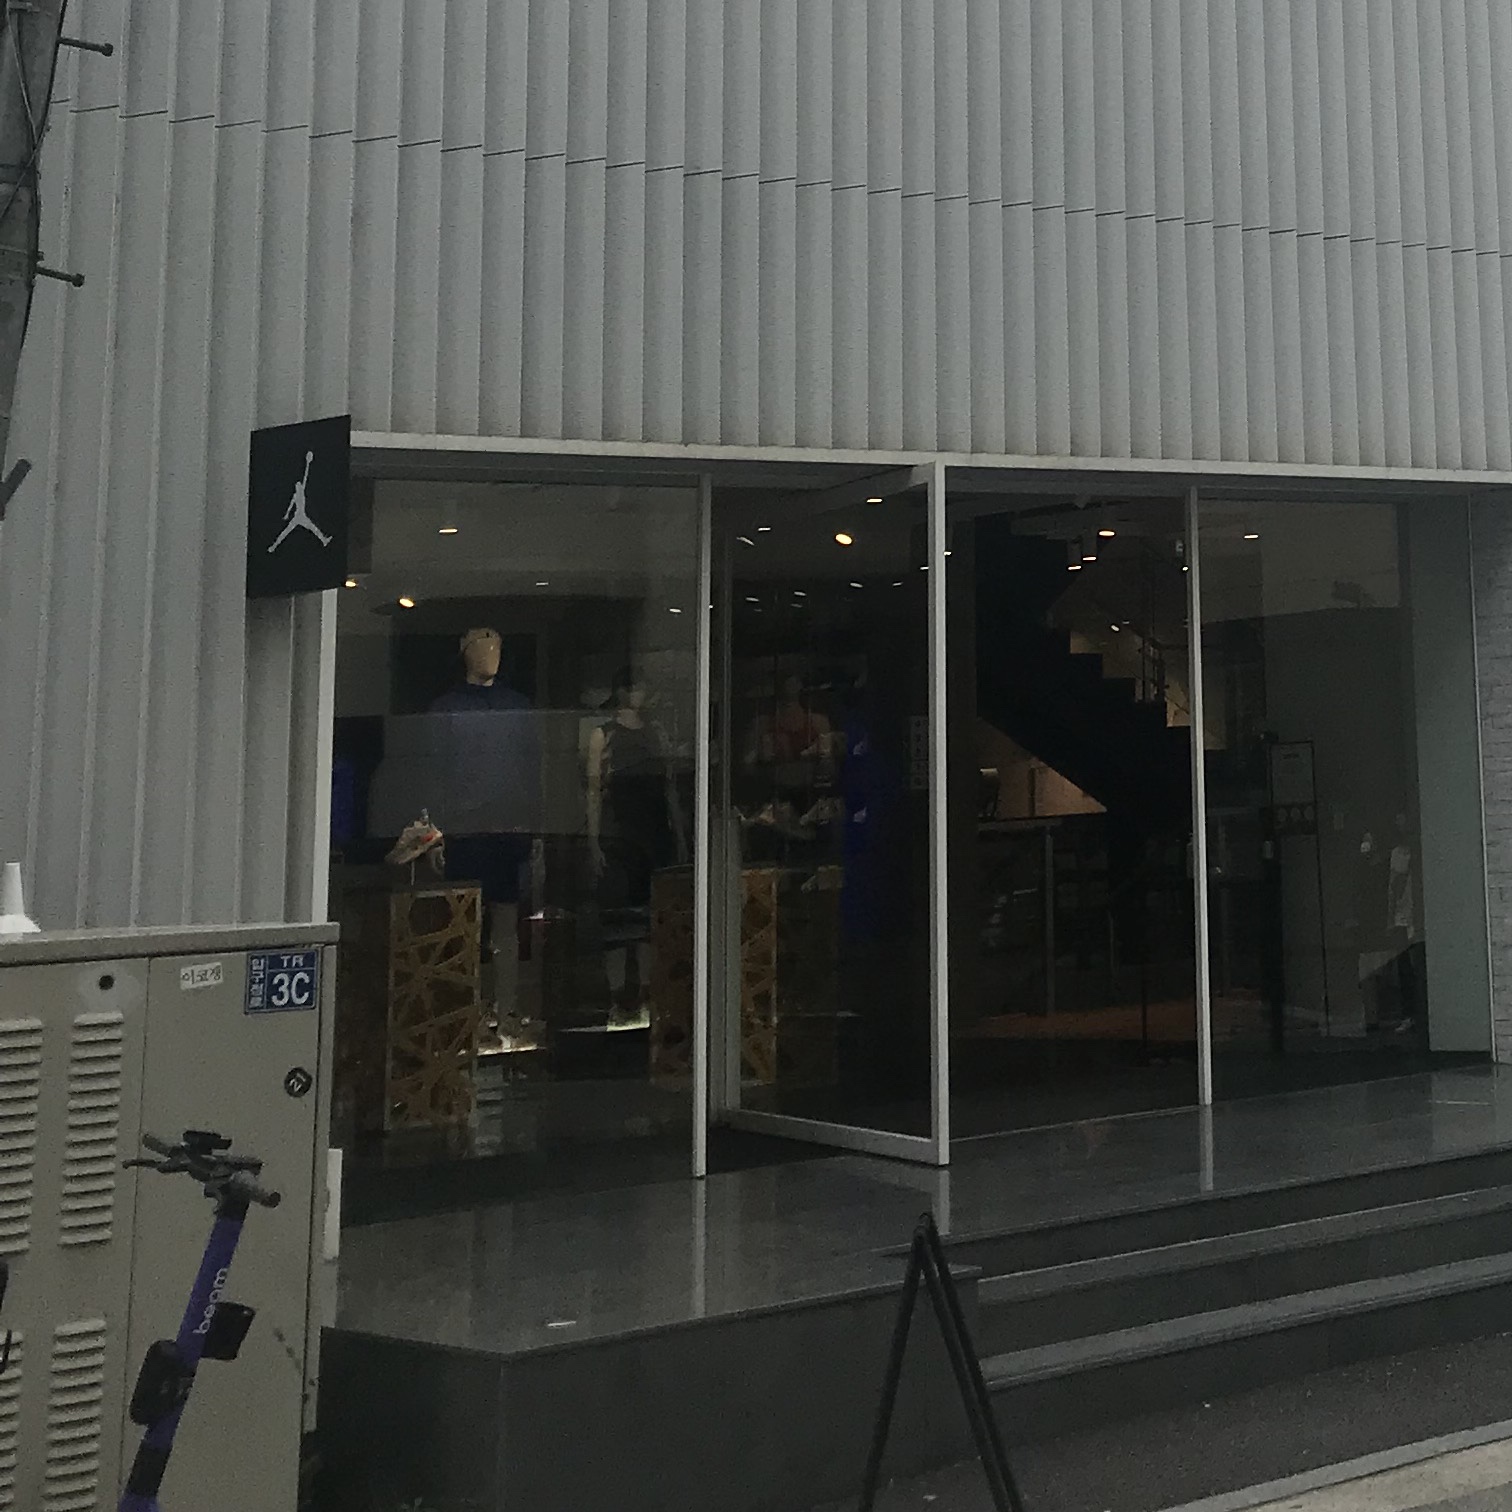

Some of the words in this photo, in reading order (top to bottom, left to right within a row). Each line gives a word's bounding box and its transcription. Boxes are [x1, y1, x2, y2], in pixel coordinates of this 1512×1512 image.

[280, 954, 304, 968] TR
[271, 971, 310, 1006] 3C
[192, 1268, 228, 1334] beam
